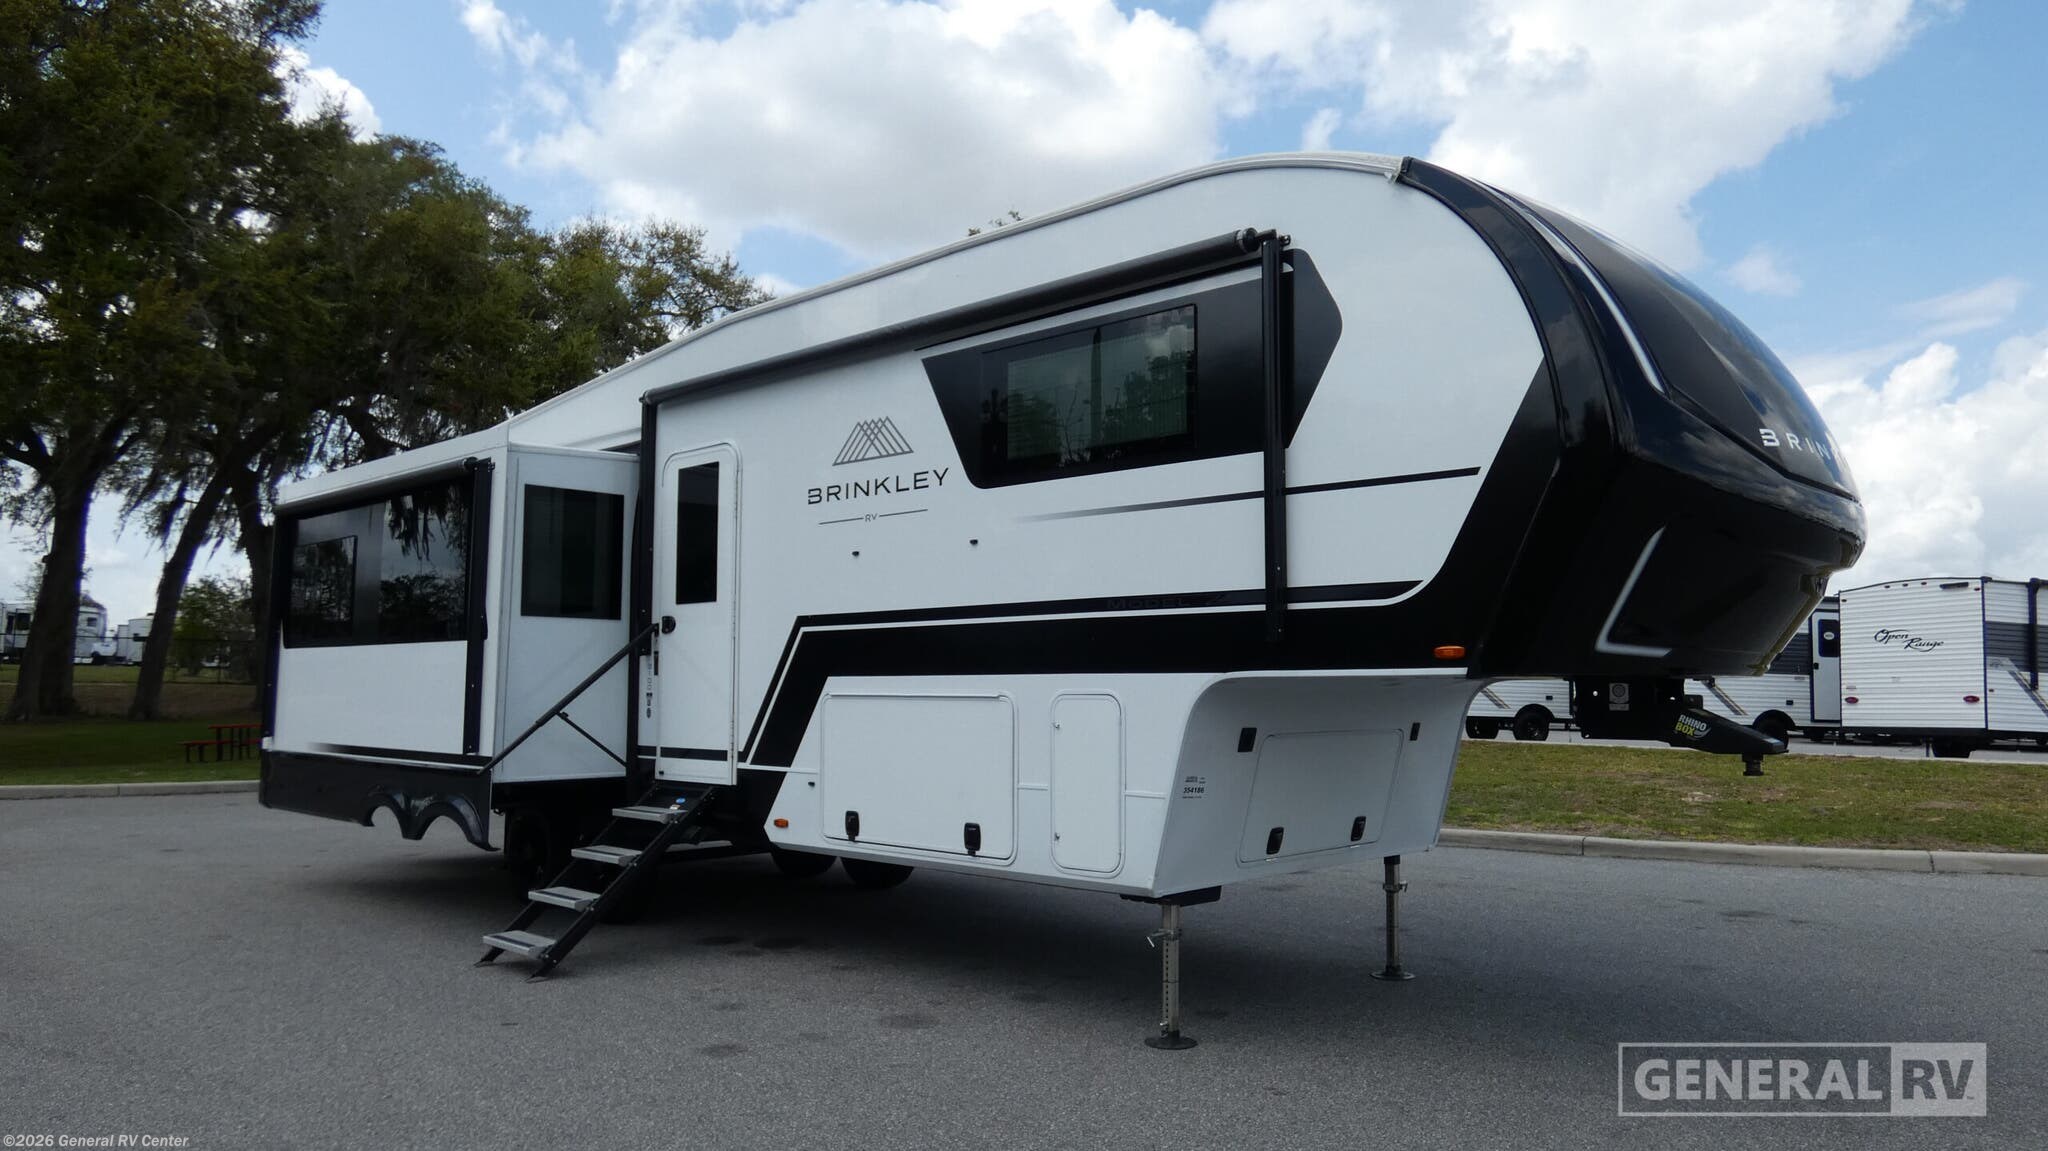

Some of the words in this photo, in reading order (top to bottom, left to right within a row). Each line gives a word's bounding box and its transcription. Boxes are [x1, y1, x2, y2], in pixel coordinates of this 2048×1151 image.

[1759, 428, 1838, 464] BRIN
[807, 467, 949, 505] BRINKLEY
[864, 513, 878, 522] RV
[1108, 598, 1192, 610] MODEL
[1874, 629, 1909, 645] Open
[1902, 637, 1945, 652] Range
[1674, 722, 1695, 736] BOX
[1679, 714, 1707, 731] RHINO
